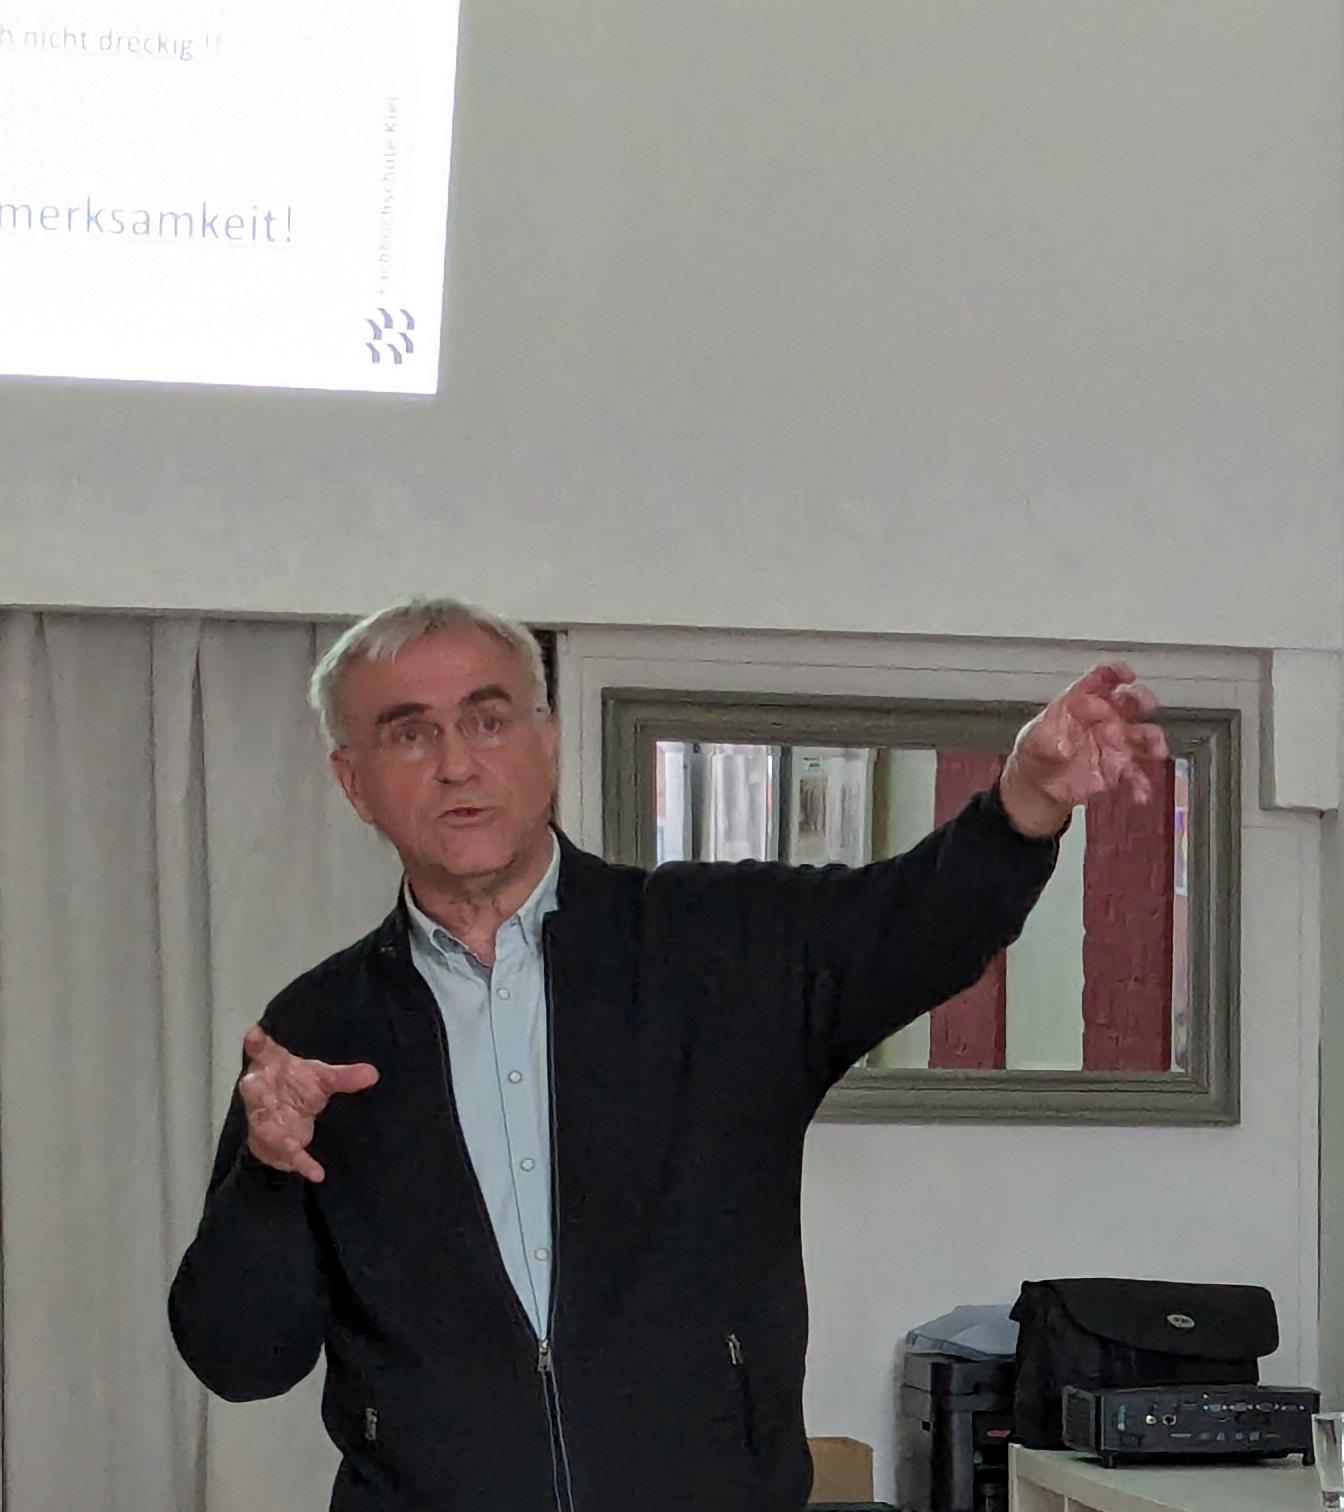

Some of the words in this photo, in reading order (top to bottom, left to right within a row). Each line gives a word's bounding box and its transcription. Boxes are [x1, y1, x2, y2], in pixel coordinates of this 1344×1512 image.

[23, 25, 88, 51] nicht
[99, 29, 193, 61] dreckig
[0, 196, 292, 244] merksamkeit!
